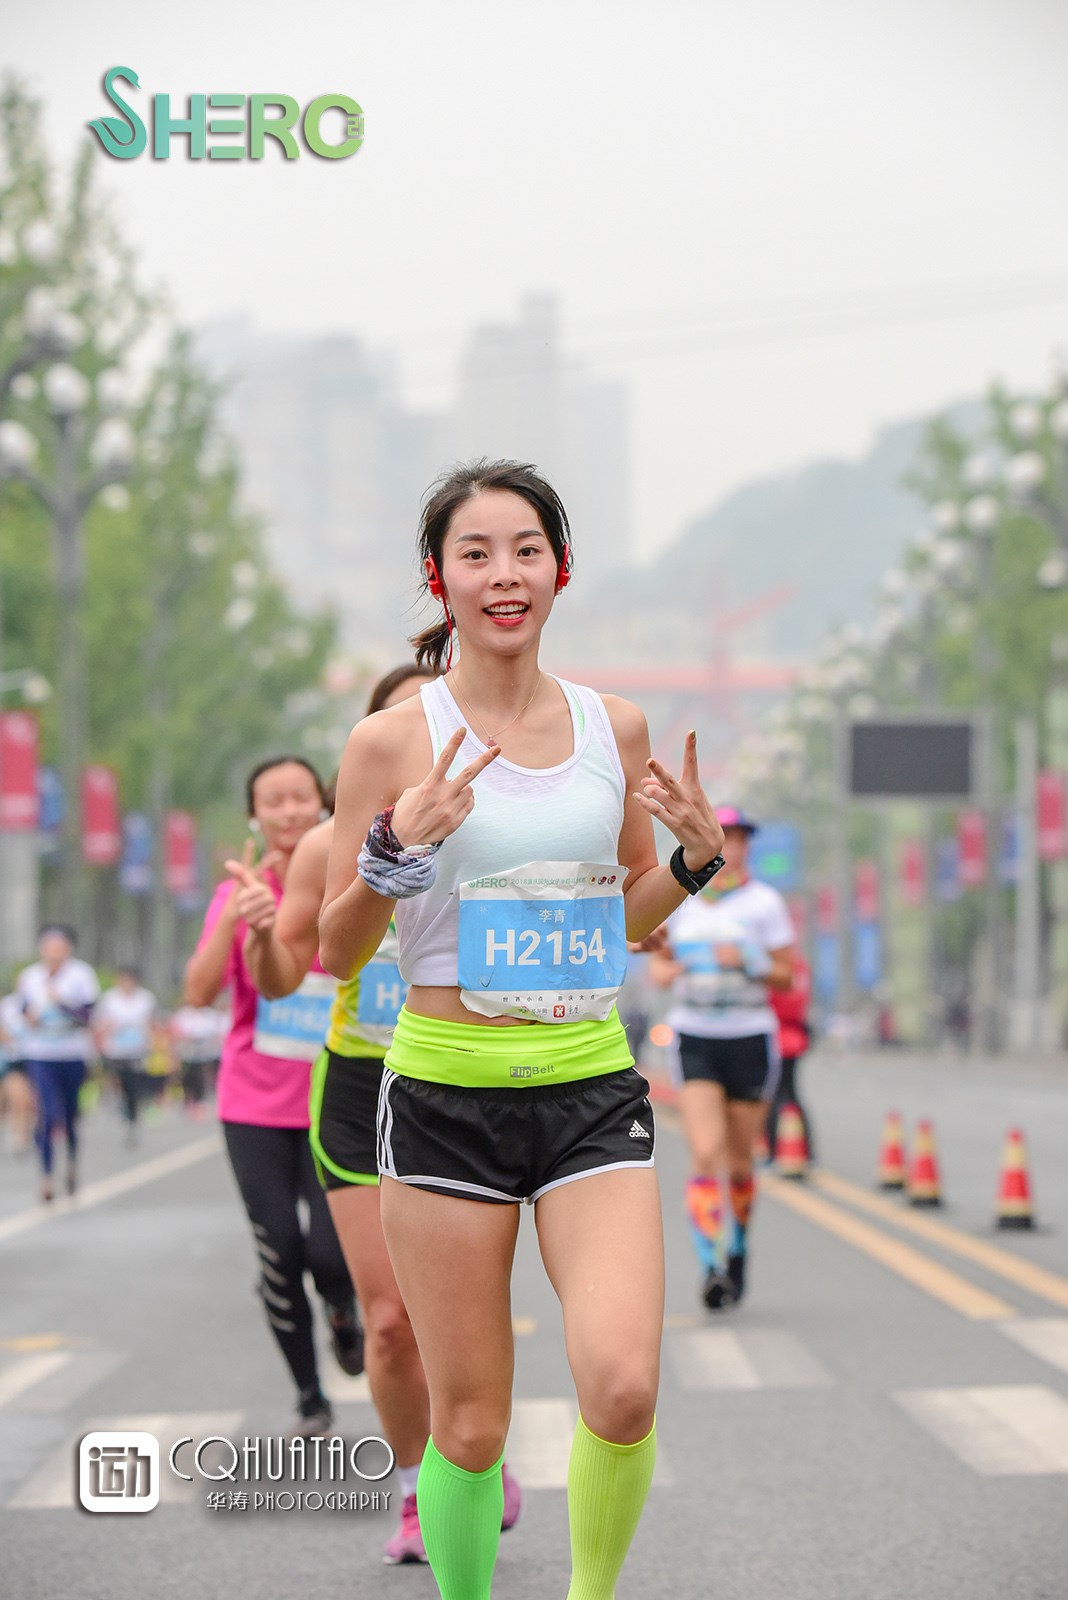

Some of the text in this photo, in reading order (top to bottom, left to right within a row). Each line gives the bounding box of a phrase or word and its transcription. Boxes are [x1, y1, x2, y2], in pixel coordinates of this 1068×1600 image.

[539, 908, 566, 923] 李青
[486, 928, 606, 966] H2154
[377, 982, 410, 1009] H
[510, 1065, 555, 1078] FlipBelt
